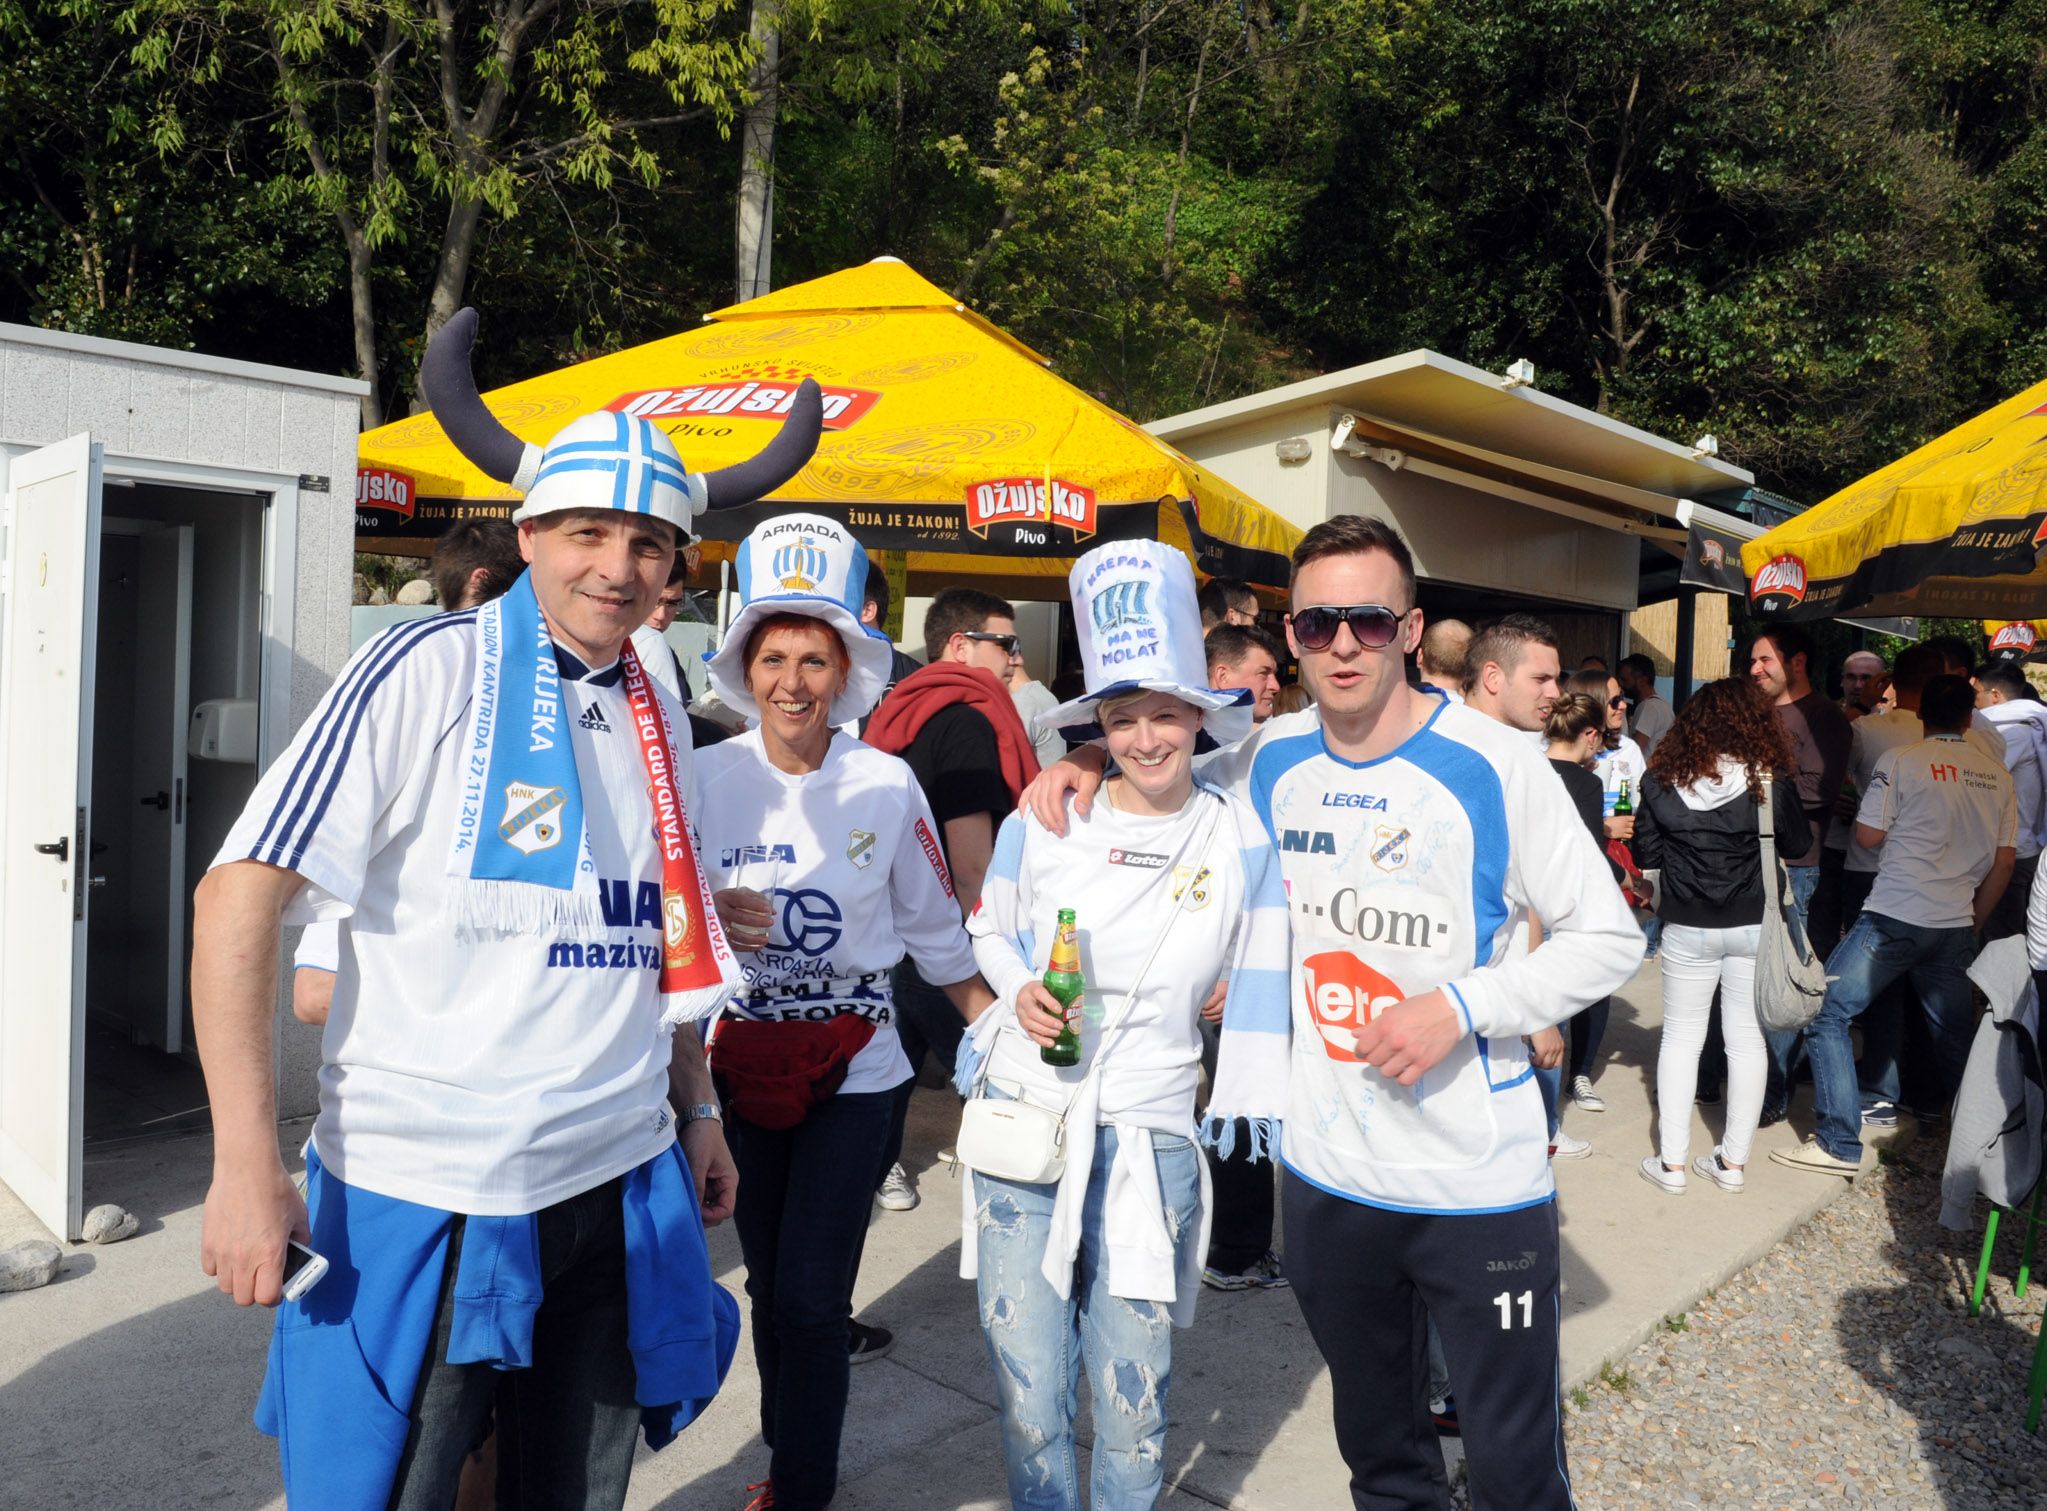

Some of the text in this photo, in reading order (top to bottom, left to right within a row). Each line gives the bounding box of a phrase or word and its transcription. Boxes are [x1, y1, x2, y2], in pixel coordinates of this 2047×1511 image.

[820, 465, 882, 490] 1892
[419, 504, 510, 519] ŽUJA JE ZAKON!
[976, 480, 1086, 522] Ožujsko
[849, 508, 960, 530] ŽUJA JE ZAKON!
[762, 523, 842, 544] ARMADA
[1015, 528, 1046, 544] Pivo
[1976, 532, 1993, 548] JE
[1754, 557, 1804, 593] Ožujsko
[1102, 641, 1159, 667] MOLAT
[474, 661, 496, 750] KANTRIDA
[529, 656, 559, 753] RIJEKA
[578, 719, 611, 734] adidas
[621, 651, 683, 861] STANDARD DE LIÈGE
[1930, 763, 1958, 783] HT
[1963, 768, 1998, 781] Hrvatski
[1964, 779, 1998, 791] Telekom
[454, 754, 486, 854] 27.11.2014.
[510, 788, 535, 800] HNK
[1321, 792, 1388, 812] LEGEA
[505, 790, 562, 836] RIJEKA
[1278, 828, 1336, 855] NA
[599, 878, 663, 930] NA
[706, 911, 730, 961] STADE
[547, 936, 661, 970] maziva
[755, 951, 835, 975] CROATIA
[780, 1003, 890, 1024] FORZA
[1486, 1258, 1530, 1272] JAKO
[1493, 1290, 1533, 1330] 11
